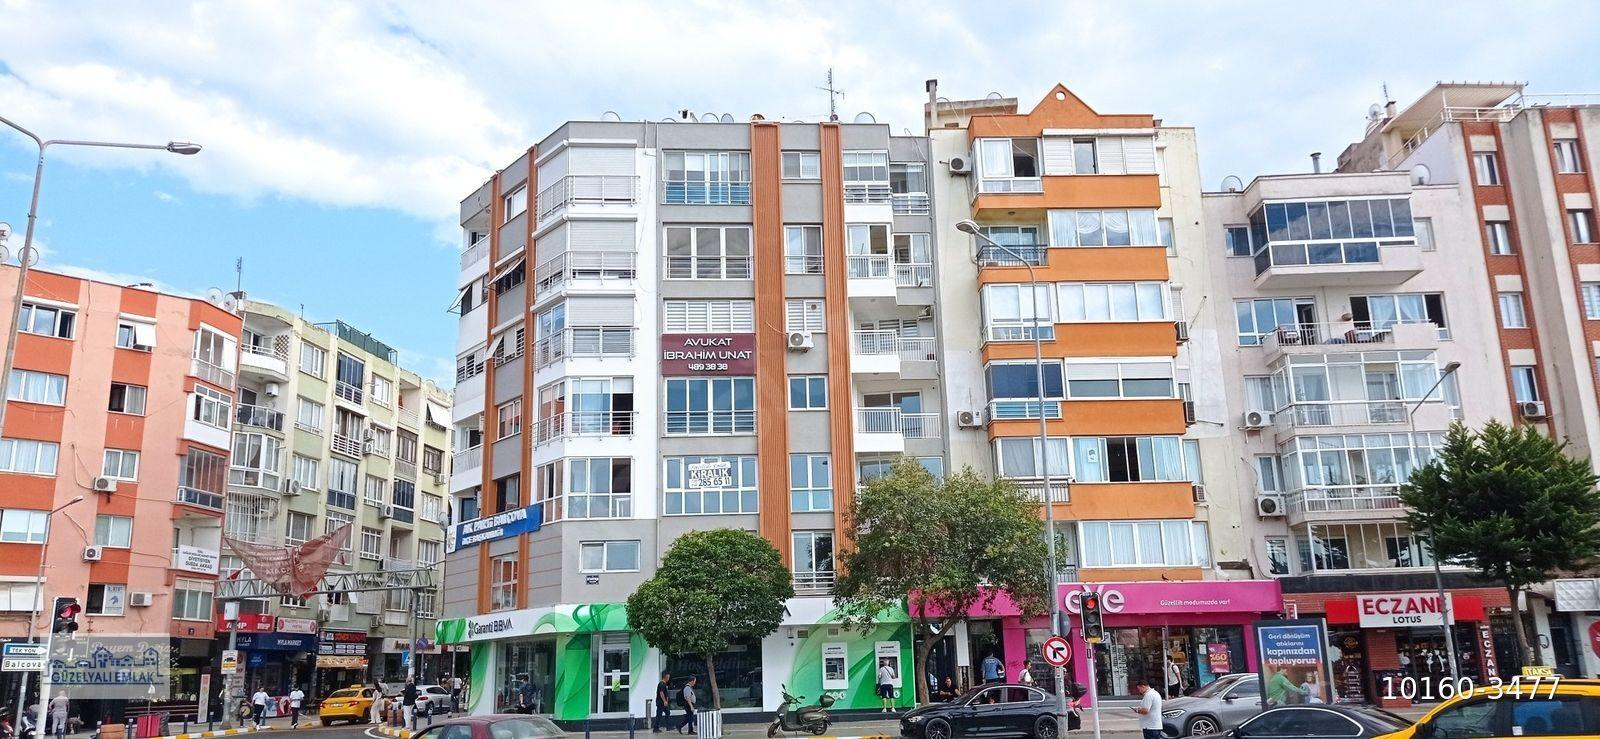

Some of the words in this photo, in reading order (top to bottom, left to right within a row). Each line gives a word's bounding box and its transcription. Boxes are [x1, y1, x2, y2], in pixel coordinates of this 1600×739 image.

[684, 338, 732, 346] AVUKAT
[664, 350, 716, 360] İBRAHİM
[719, 351, 752, 359] UNAT
[699, 478, 712, 486] 285
[714, 477, 722, 485] 65
[464, 524, 474, 535] AK
[474, 622, 494, 634] Garanti
[494, 618, 513, 632] BBVA
[1267, 648, 1316, 656] kapınızdan
[1481, 630, 1496, 676] ECZAN
[1269, 657, 1316, 666] topluyoruz
